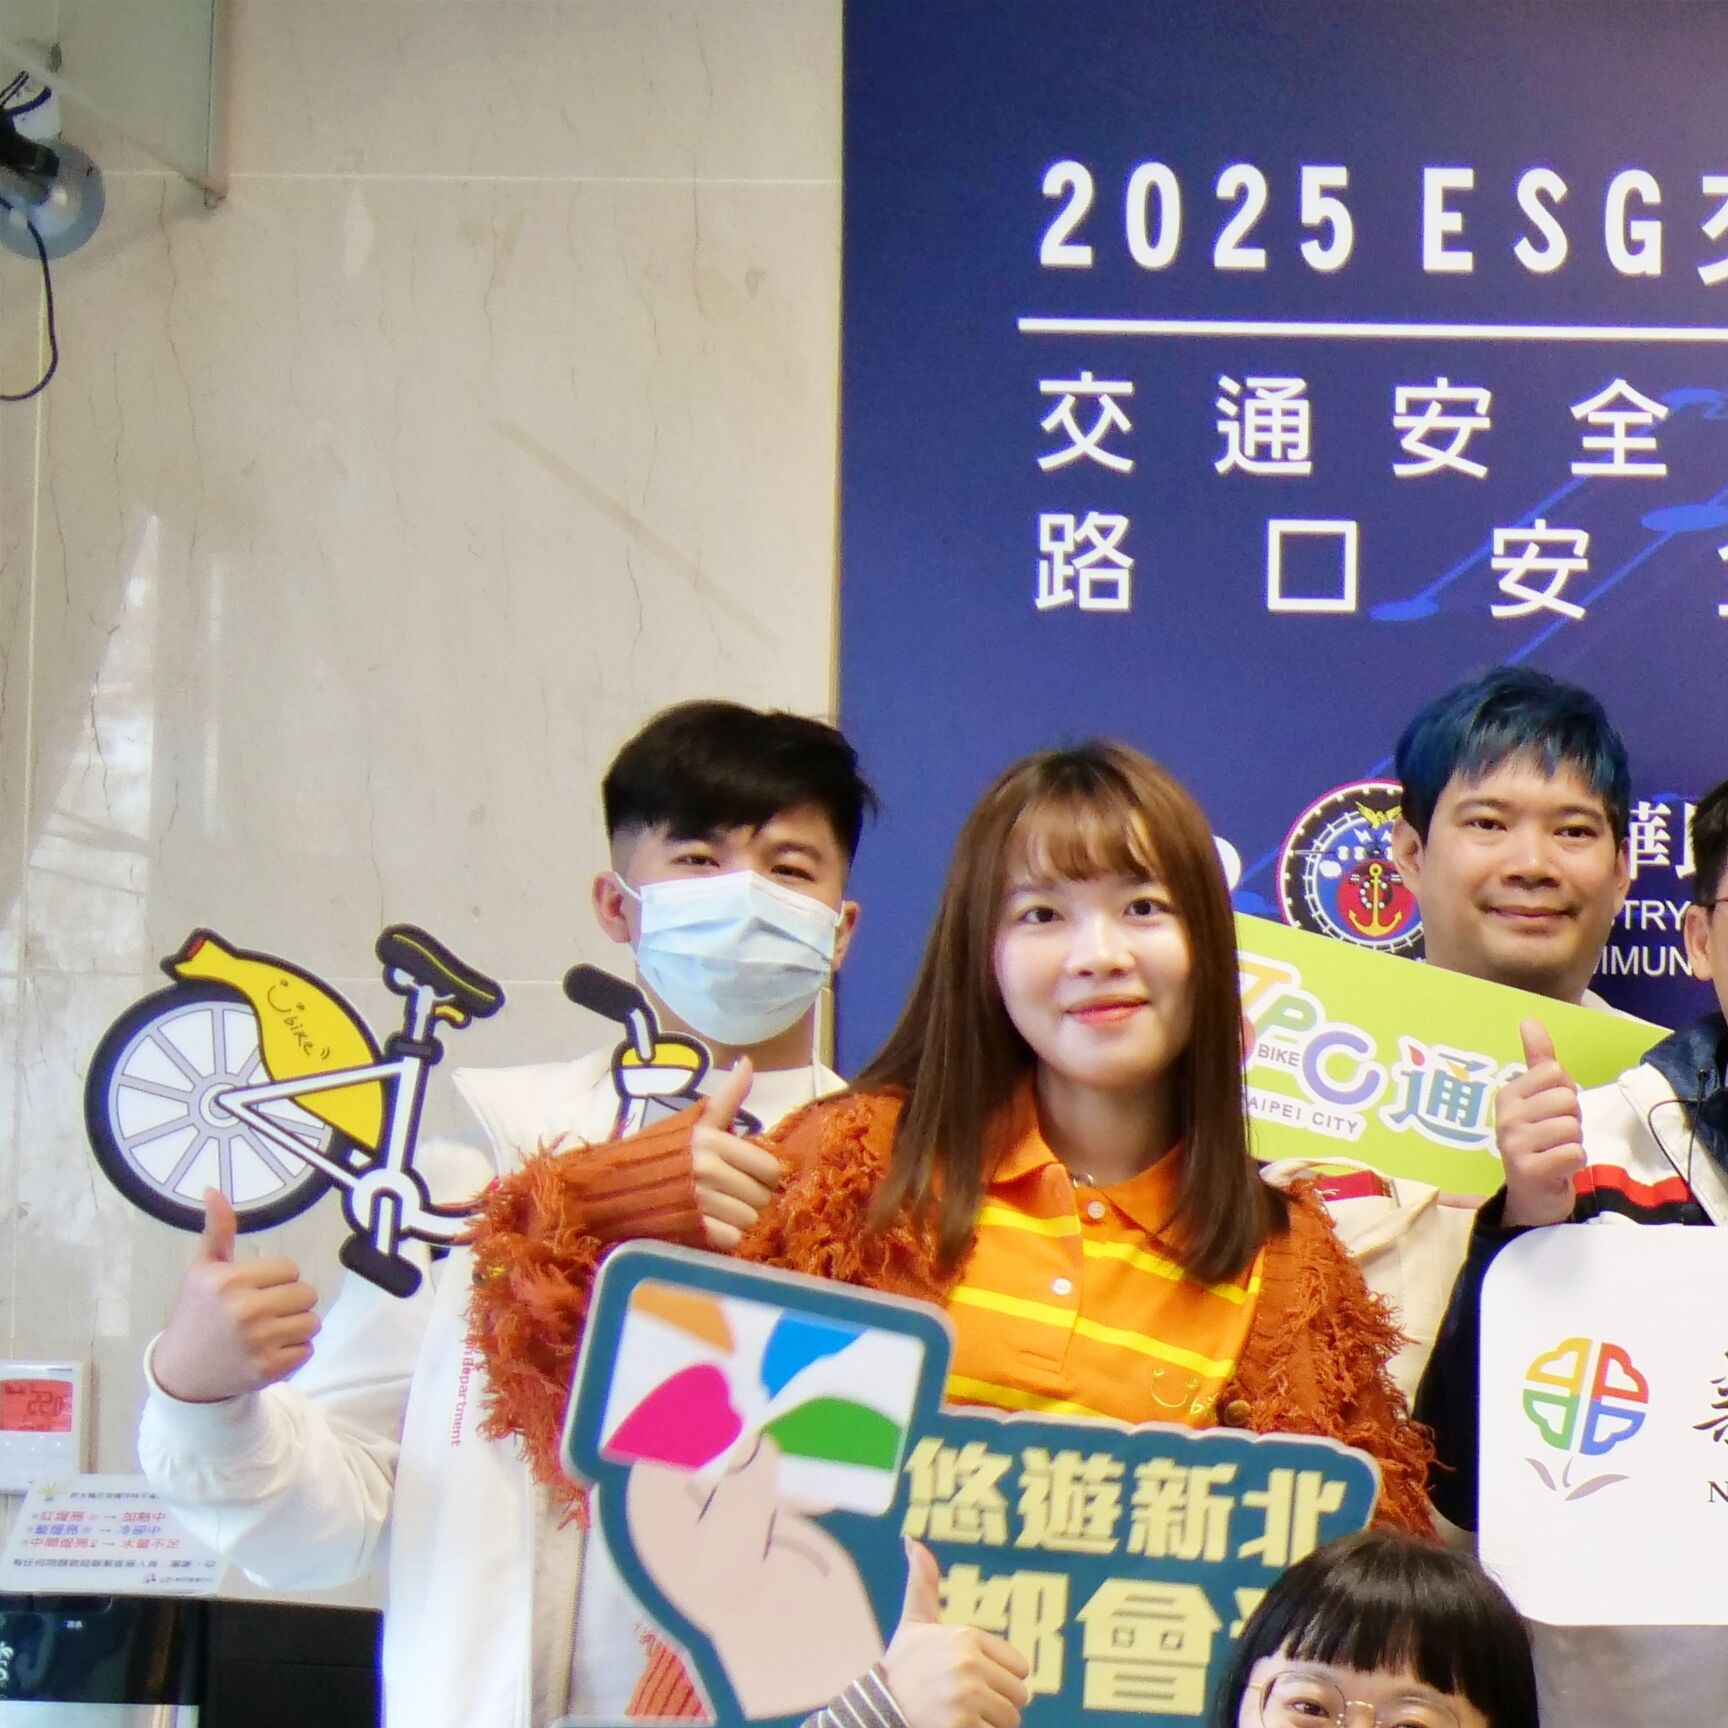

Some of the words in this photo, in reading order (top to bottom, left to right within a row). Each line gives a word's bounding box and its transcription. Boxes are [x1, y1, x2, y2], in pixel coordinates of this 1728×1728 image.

[1040, 159, 1355, 271] 2025
[1257, 1043, 1301, 1068] BIKE
[1311, 1110, 1359, 1134] CITY
[901, 1437, 1347, 1568] 悠遊新北
